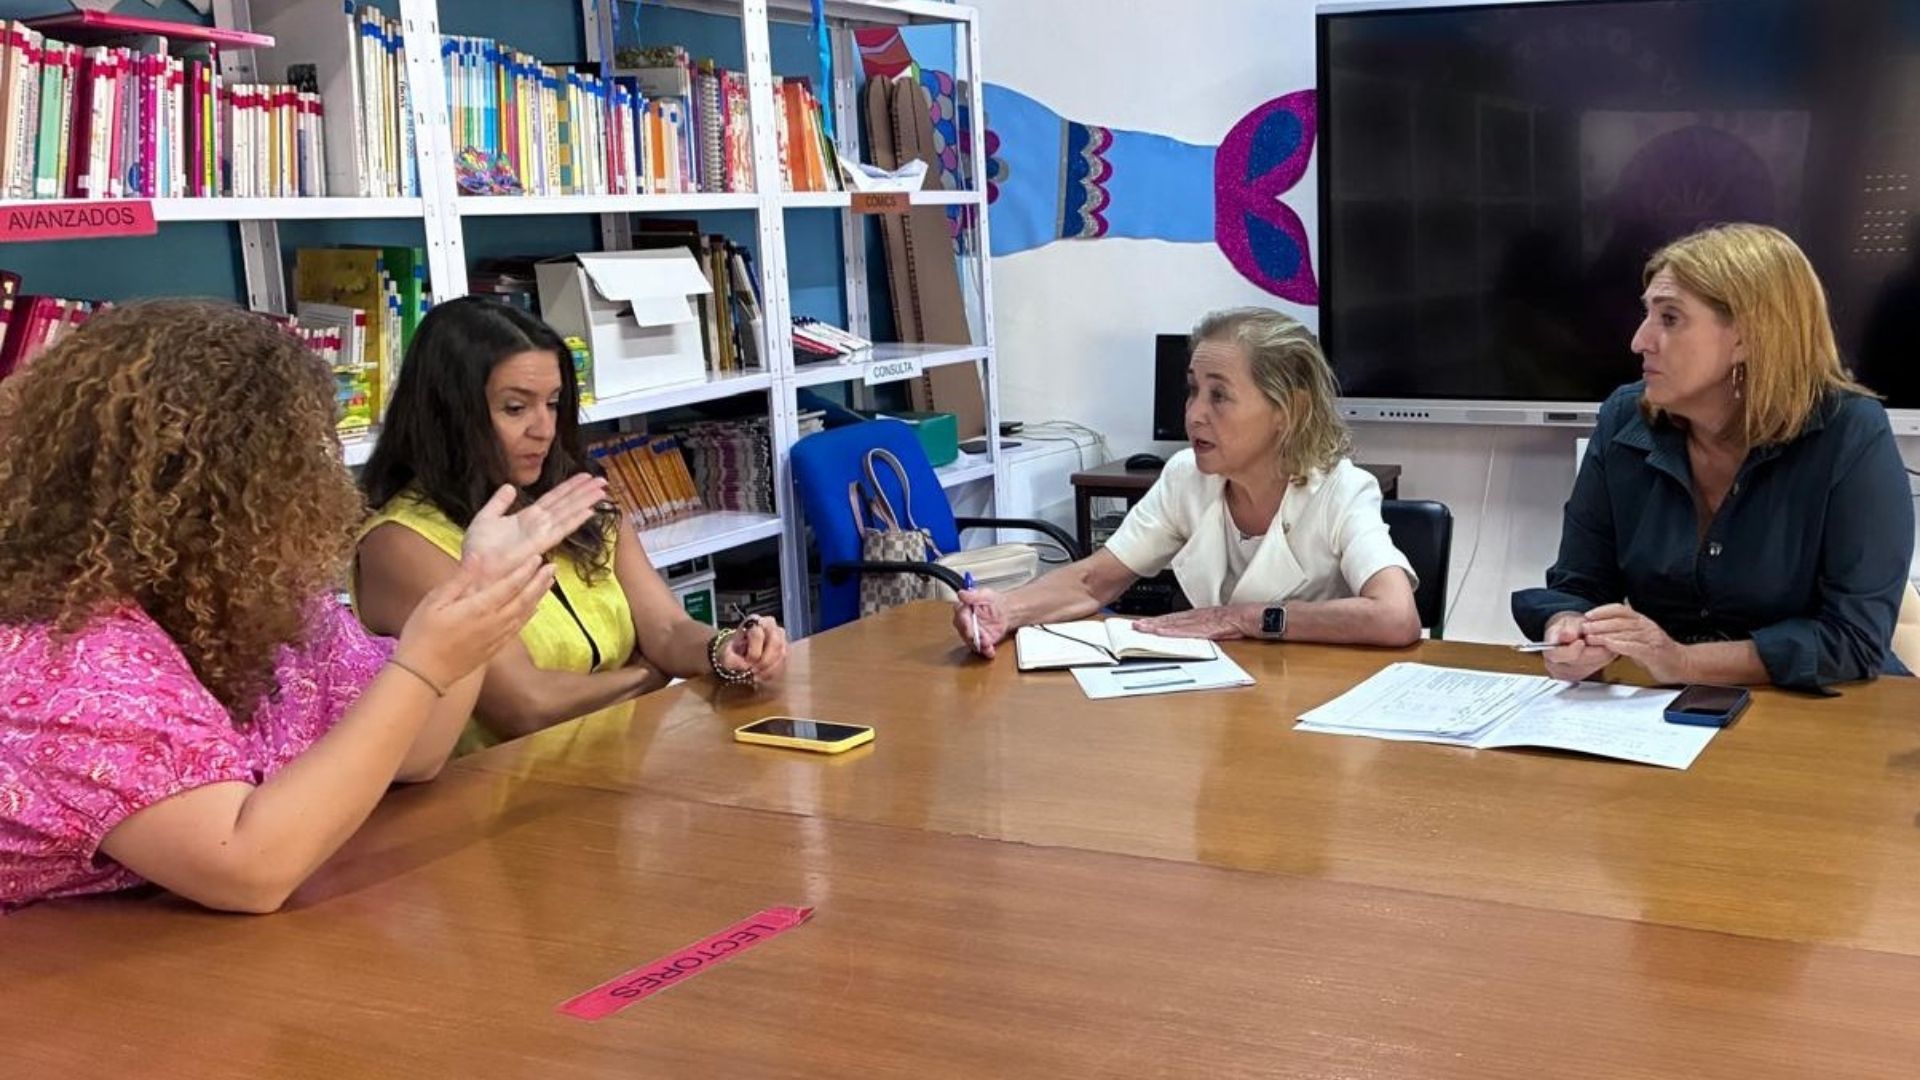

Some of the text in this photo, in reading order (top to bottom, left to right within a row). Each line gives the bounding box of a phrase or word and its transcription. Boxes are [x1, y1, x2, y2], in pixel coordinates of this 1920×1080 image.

[8, 207, 135, 231] AVANZADOS
[874, 362, 914, 378] CONSULTA
[611, 924, 777, 999] LECTORES
